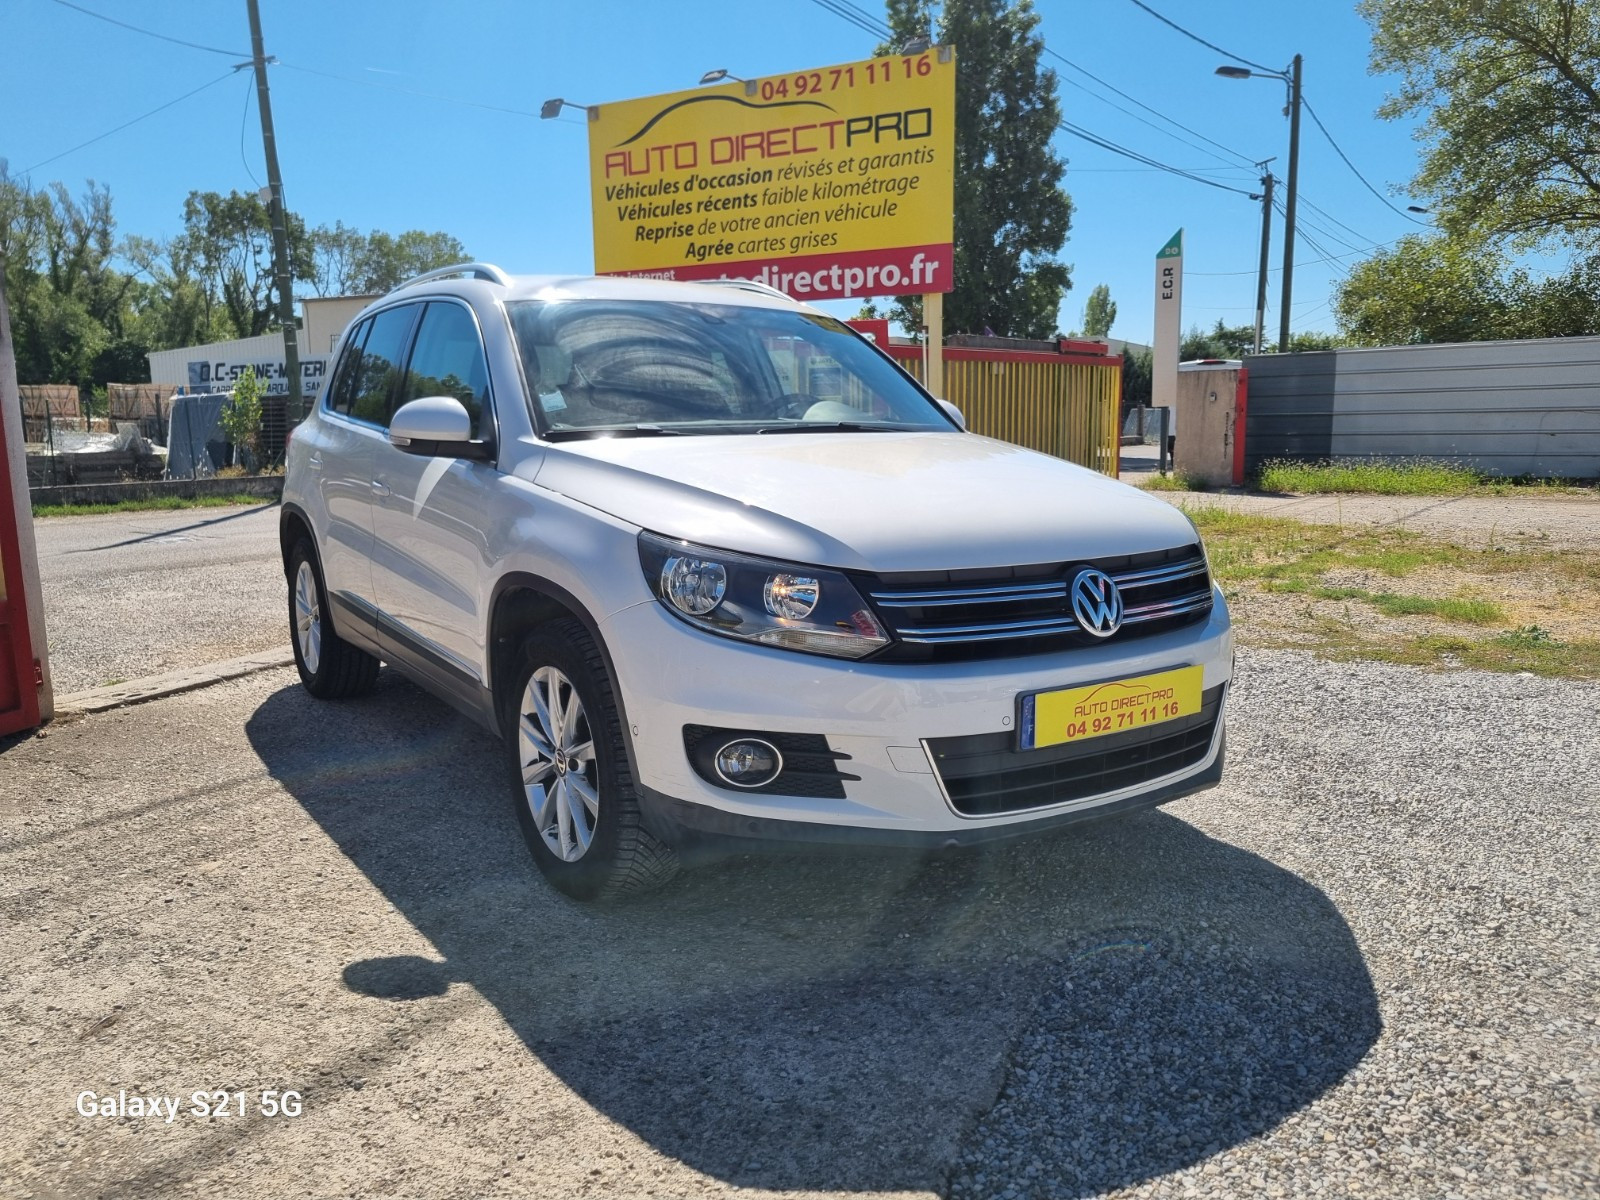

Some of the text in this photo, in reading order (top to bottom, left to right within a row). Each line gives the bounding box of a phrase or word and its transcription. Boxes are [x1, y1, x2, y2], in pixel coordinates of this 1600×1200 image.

[761, 54, 932, 101] 04 92 71 11 16
[605, 141, 698, 179] AUTO
[605, 145, 935, 202] Véhicules d'occasion révisés et garantis
[617, 175, 920, 223] Véhicules récents faible kilométrage
[635, 198, 898, 244] Reprise de votre ancien véhicule
[685, 231, 838, 262] Agrée cartes grises
[1066, 701, 1179, 738] 04 92 71 11 16
[1074, 701, 1108, 718] AUTO
